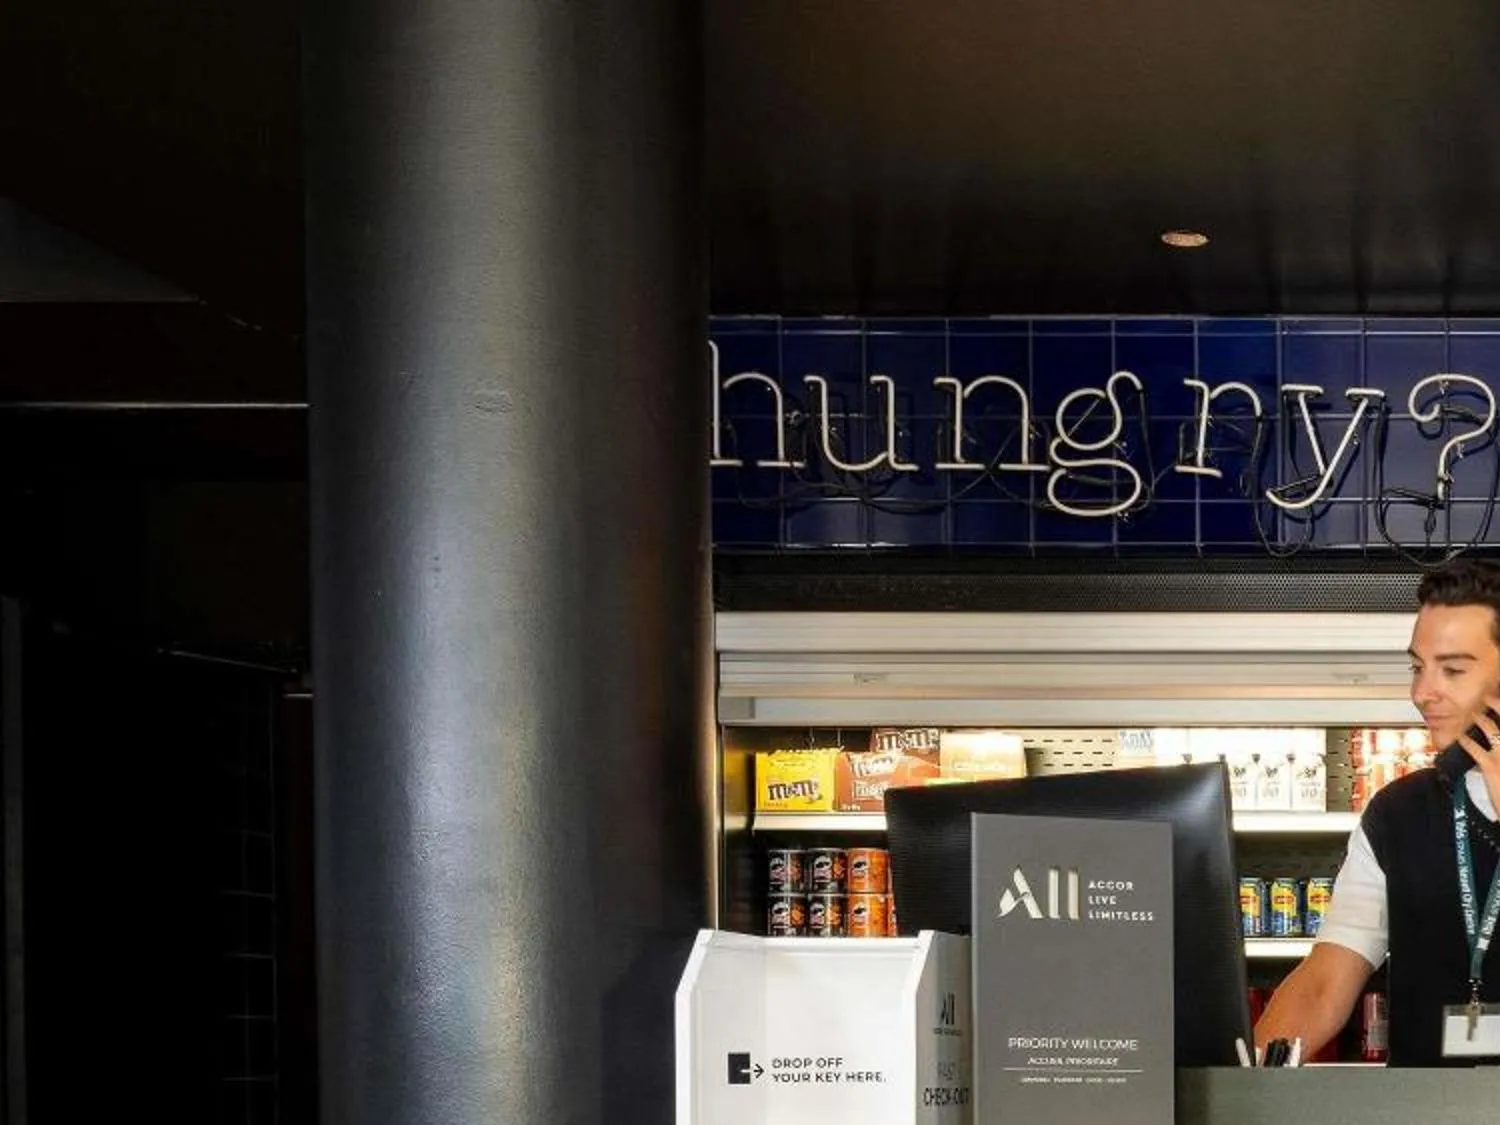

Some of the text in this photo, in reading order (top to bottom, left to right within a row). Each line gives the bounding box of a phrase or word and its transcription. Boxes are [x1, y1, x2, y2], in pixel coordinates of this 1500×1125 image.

[709, 340, 1497, 516] hungry?
[1087, 880, 1134, 890] ACCOR
[998, 865, 1080, 920] All
[1087, 895, 1117, 905] LIVE
[1087, 911, 1154, 921] LIMITLESS
[1007, 1037, 1139, 1050] PRIORITY WELCOME
[771, 1057, 843, 1069] DROP OFF
[771, 1071, 887, 1083] YOUR KEY HERE.
